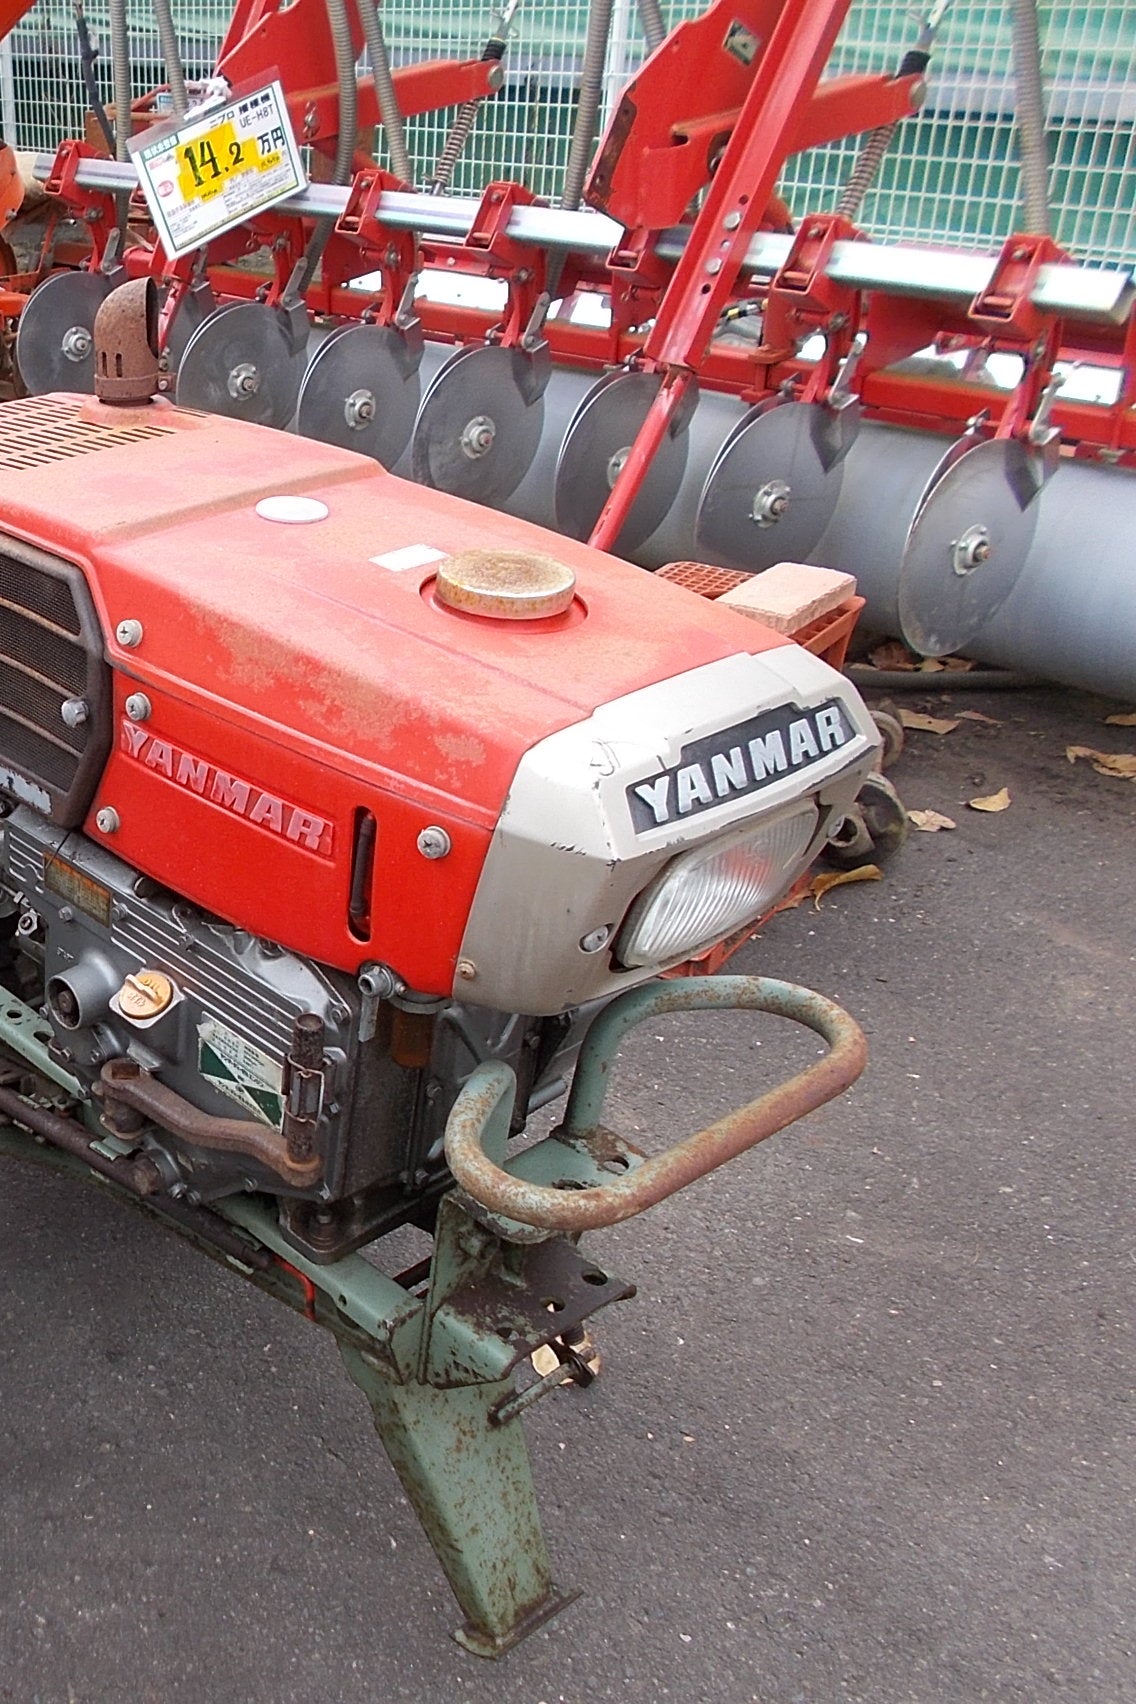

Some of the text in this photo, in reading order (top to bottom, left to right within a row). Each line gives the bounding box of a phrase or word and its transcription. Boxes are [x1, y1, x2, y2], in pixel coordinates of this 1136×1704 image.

[184, 140, 245, 188] 14.2
[256, 126, 286, 155] 万円
[240, 104, 274, 128] UE-H8T
[122, 720, 326, 850] YANMAR
[634, 706, 845, 824] YANMAR
